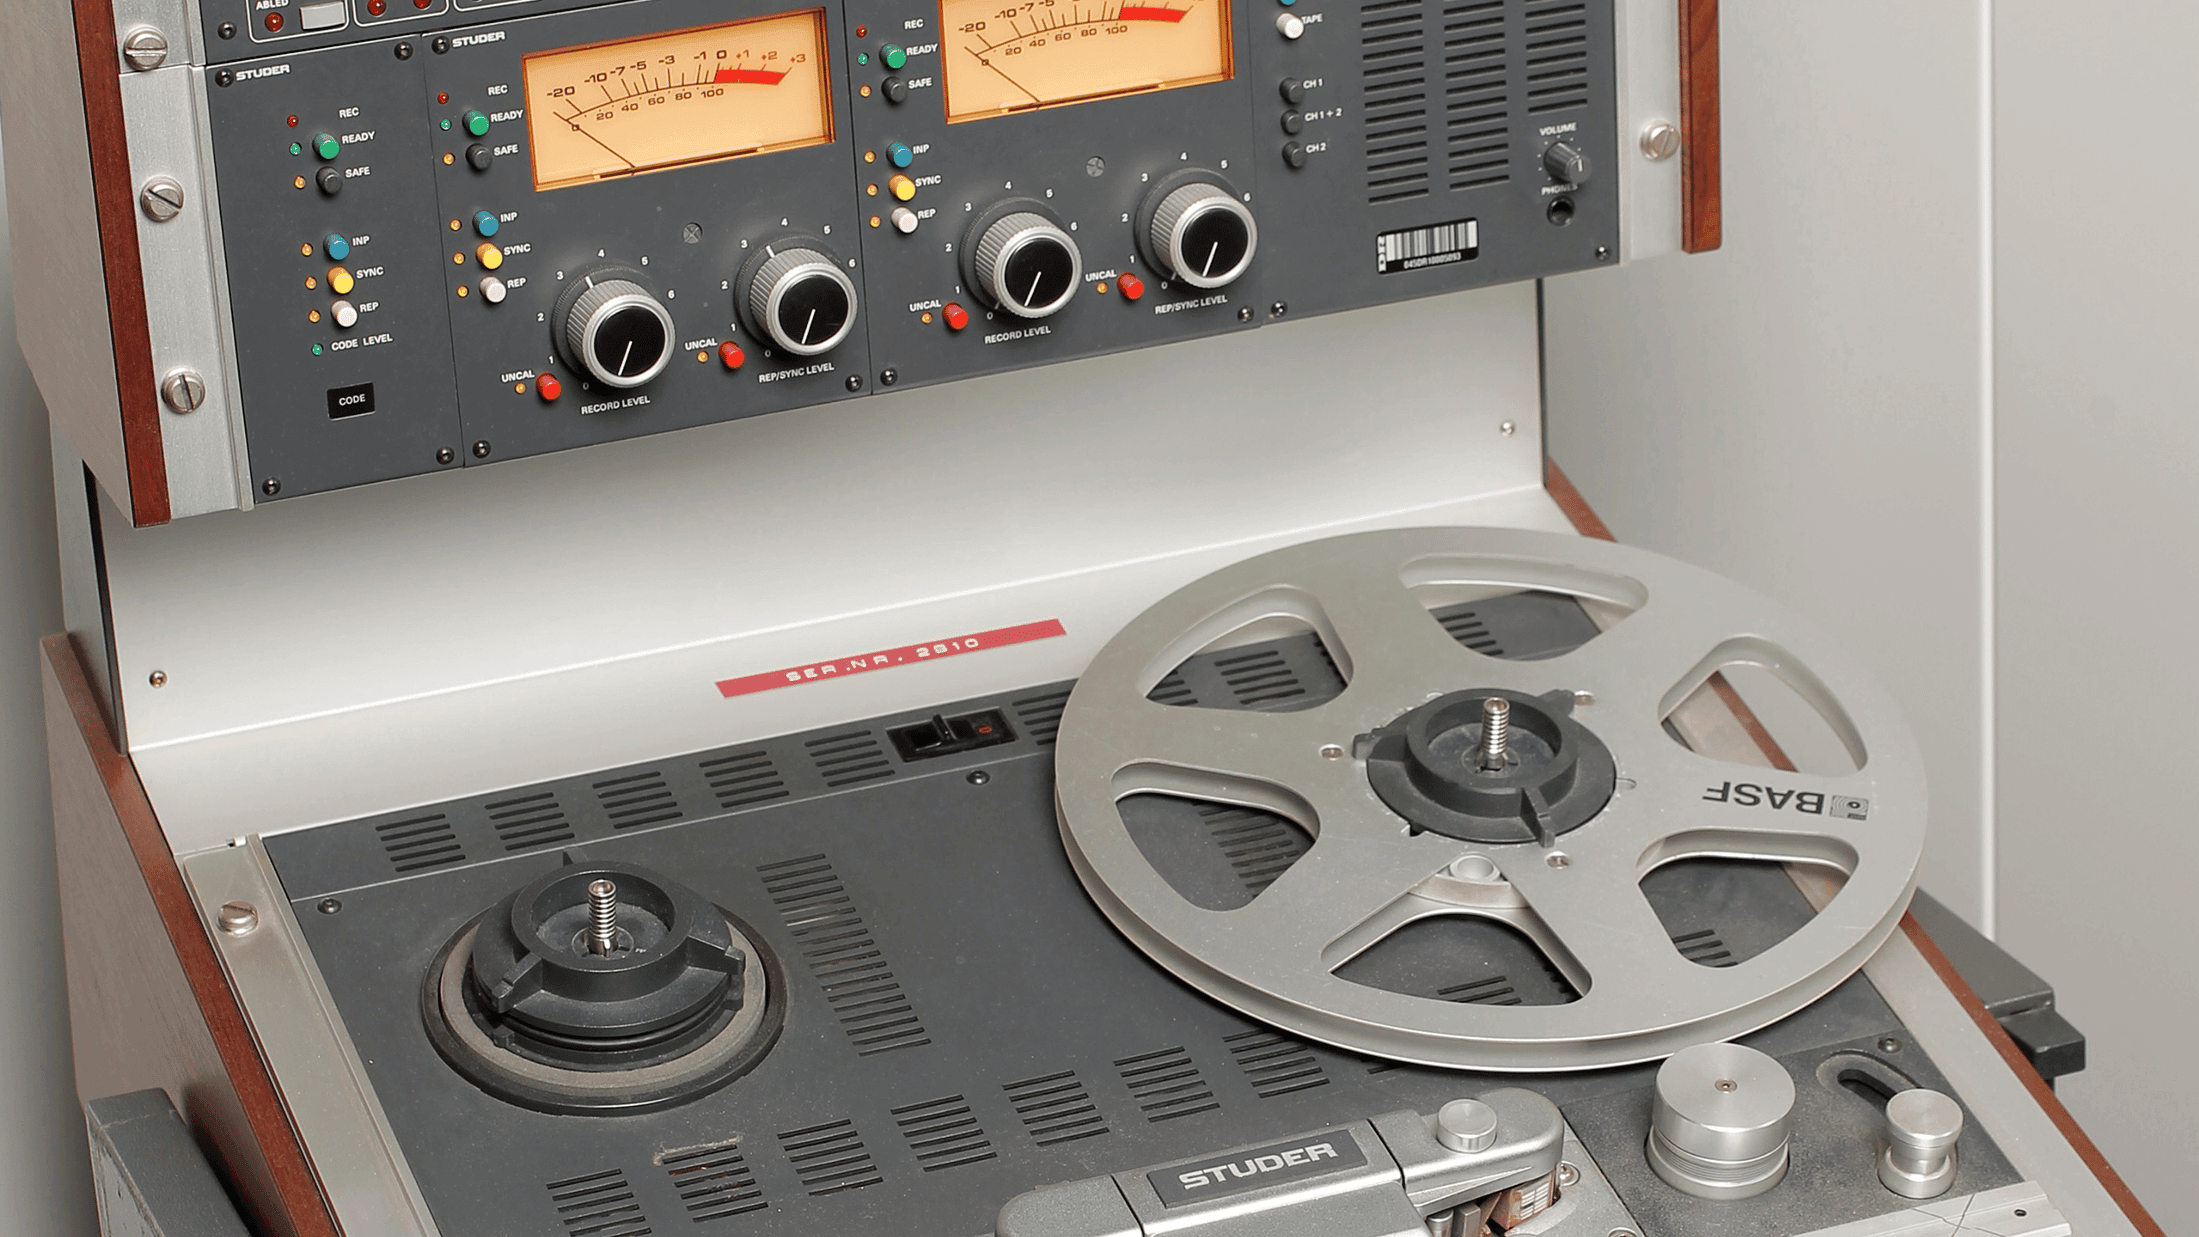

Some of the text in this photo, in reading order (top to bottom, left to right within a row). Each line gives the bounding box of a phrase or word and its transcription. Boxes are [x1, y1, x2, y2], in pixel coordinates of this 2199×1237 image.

[904, 19, 924, 30] REC
[1302, 14, 1323, 24] TAPE
[959, 22, 986, 33] -20
[452, 31, 506, 48] STUDER
[1005, 47, 1022, 56] 20
[1030, 39, 1046, 48] 40
[1106, 25, 1128, 35] 100
[906, 44, 938, 56] READY
[236, 64, 290, 81] STUDER
[547, 86, 576, 98] -20
[584, 72, 608, 84] -10
[630, 60, 647, 71] -5
[658, 55, 675, 66] -3
[908, 78, 932, 90] SAFE
[1303, 78, 1323, 89] CH 1
[488, 84, 508, 96] REC
[596, 88, 724, 121] 20 40 60 80 100
[338, 106, 360, 118] REC
[490, 110, 524, 122] READY
[1304, 112, 1318, 122] CH
[1320, 110, 1324, 119] 1
[1336, 108, 1342, 116] 2
[1540, 122, 1577, 136] VOLUME
[342, 130, 376, 144] READY
[494, 144, 518, 156] SAFE
[912, 144, 930, 154] INP
[1306, 142, 1326, 154] CH 2
[1180, 152, 1188, 160] 4
[1220, 160, 1228, 168] 5
[344, 166, 370, 178] SAFE
[1141, 173, 1148, 182] 3
[915, 175, 942, 188] SYNC
[1004, 182, 1012, 190] 4
[1046, 188, 1053, 198] 5
[1244, 192, 1251, 202] 6
[965, 203, 972, 212] 3
[500, 212, 518, 223] INP
[918, 208, 936, 220] REP
[1122, 214, 1128, 222] 2
[781, 218, 788, 226] 4
[1070, 222, 1078, 231] 6
[824, 225, 831, 234] 5
[352, 236, 370, 246] INP
[740, 240, 748, 248] 3
[504, 243, 532, 256] SYNC
[946, 243, 952, 252] 2
[598, 249, 606, 258] 4
[641, 257, 648, 266] 5
[848, 259, 856, 268] 6
[1130, 255, 1135, 264] 1
[356, 266, 384, 279] SYNC
[556, 272, 564, 280] 3
[1086, 269, 1118, 282] UNCAL
[507, 278, 526, 289] REP
[721, 281, 728, 290] 2
[668, 290, 676, 298] 6
[956, 286, 960, 294] 1
[360, 302, 379, 313] REP
[910, 299, 942, 312] UNCAL
[1155, 294, 1228, 315] REP/SYNC LEVEL
[537, 313, 544, 322] 2
[731, 324, 736, 332] 1
[984, 326, 1051, 345] RECORD LEVEL
[331, 334, 393, 352] CODE LEVEL
[685, 338, 718, 350] UNCAL
[548, 356, 554, 364] 1
[501, 370, 535, 383] UNCAL
[758, 362, 835, 383] REP/SYNC LEVEL
[338, 394, 366, 406] CODE
[581, 396, 650, 415] RECORD LEVEL
[1702, 781, 1825, 815] BASF
[1178, 1142, 1339, 1190] STUDER
